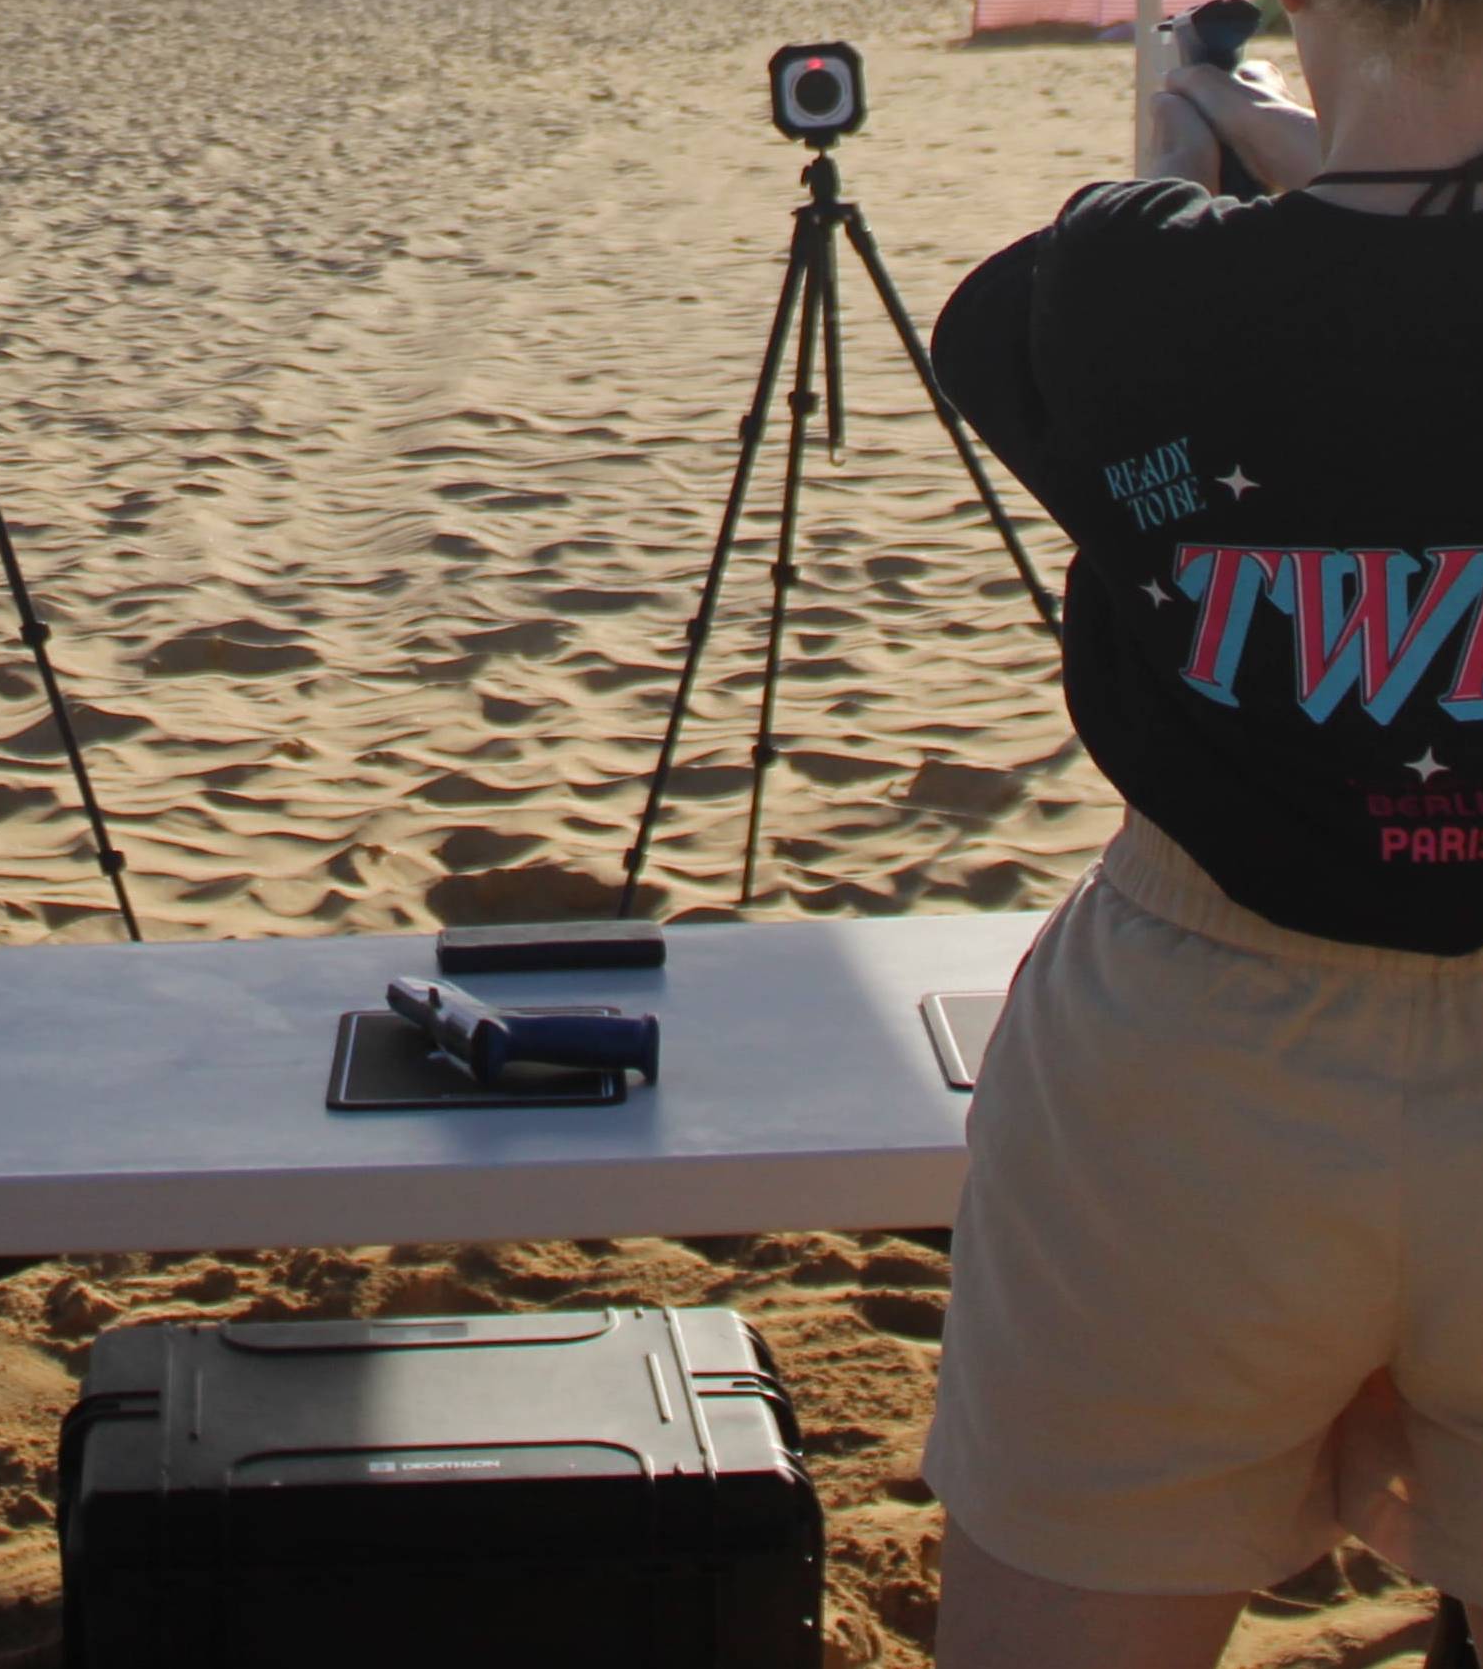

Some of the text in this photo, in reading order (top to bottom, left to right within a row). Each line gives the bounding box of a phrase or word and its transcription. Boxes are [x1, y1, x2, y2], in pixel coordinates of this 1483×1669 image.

[1105, 437, 1191, 500] READY
[1128, 476, 1207, 530] TO BE
